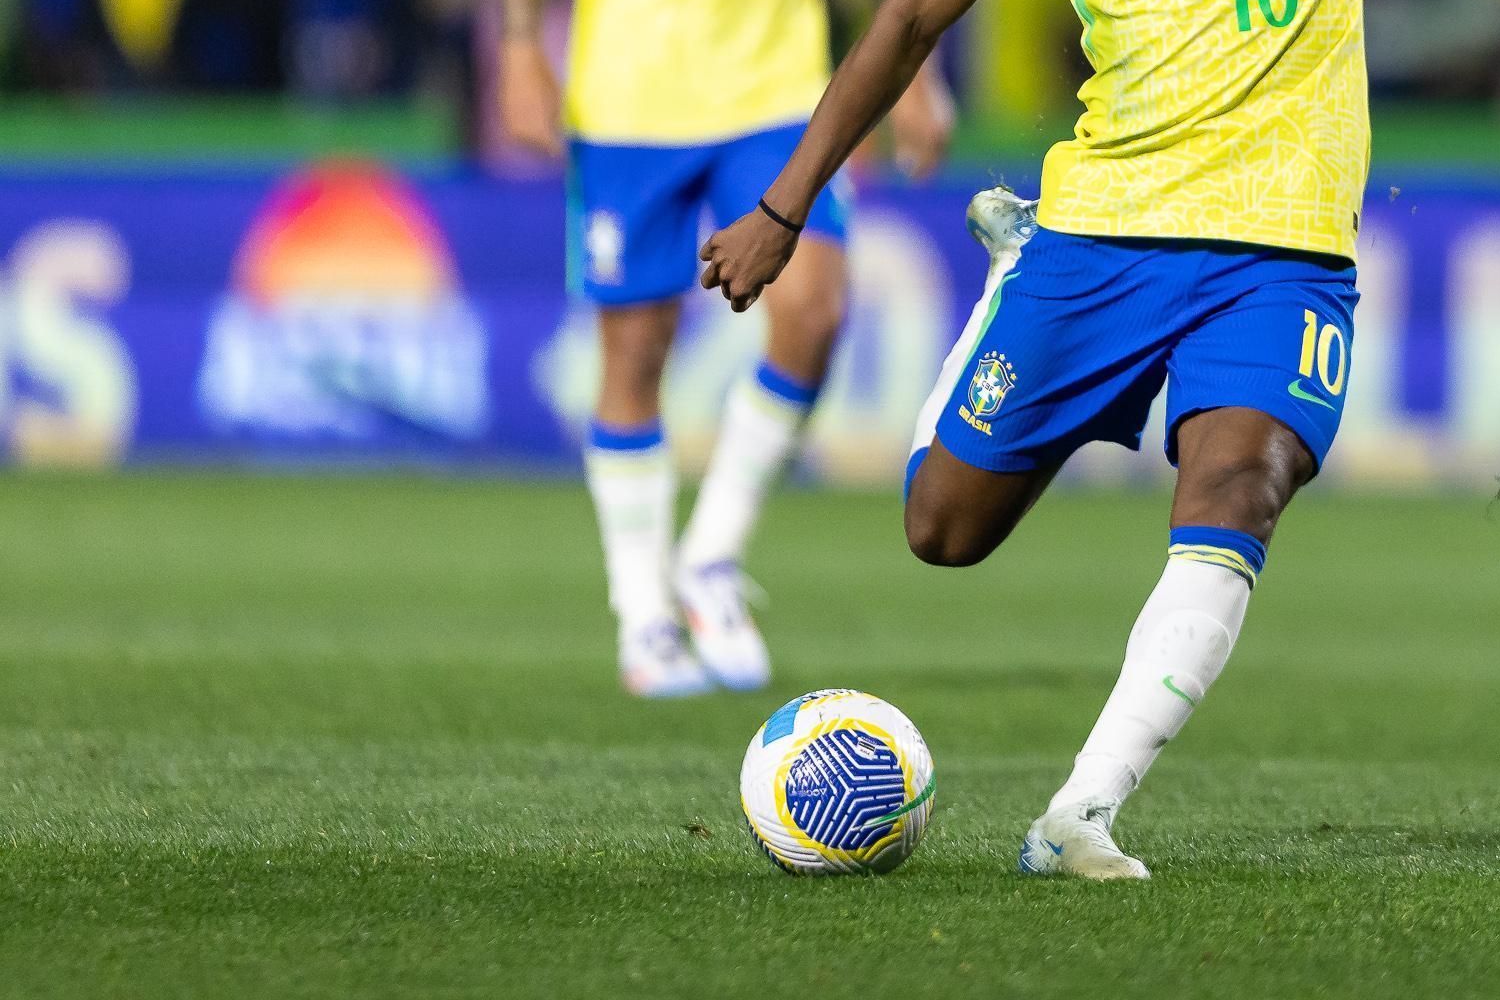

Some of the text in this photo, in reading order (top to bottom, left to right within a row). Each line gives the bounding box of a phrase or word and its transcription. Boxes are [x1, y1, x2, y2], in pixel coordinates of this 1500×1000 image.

[1299, 308, 1345, 396] 10
[981, 380, 995, 392] CBF
[958, 404, 992, 436] BRASIL
